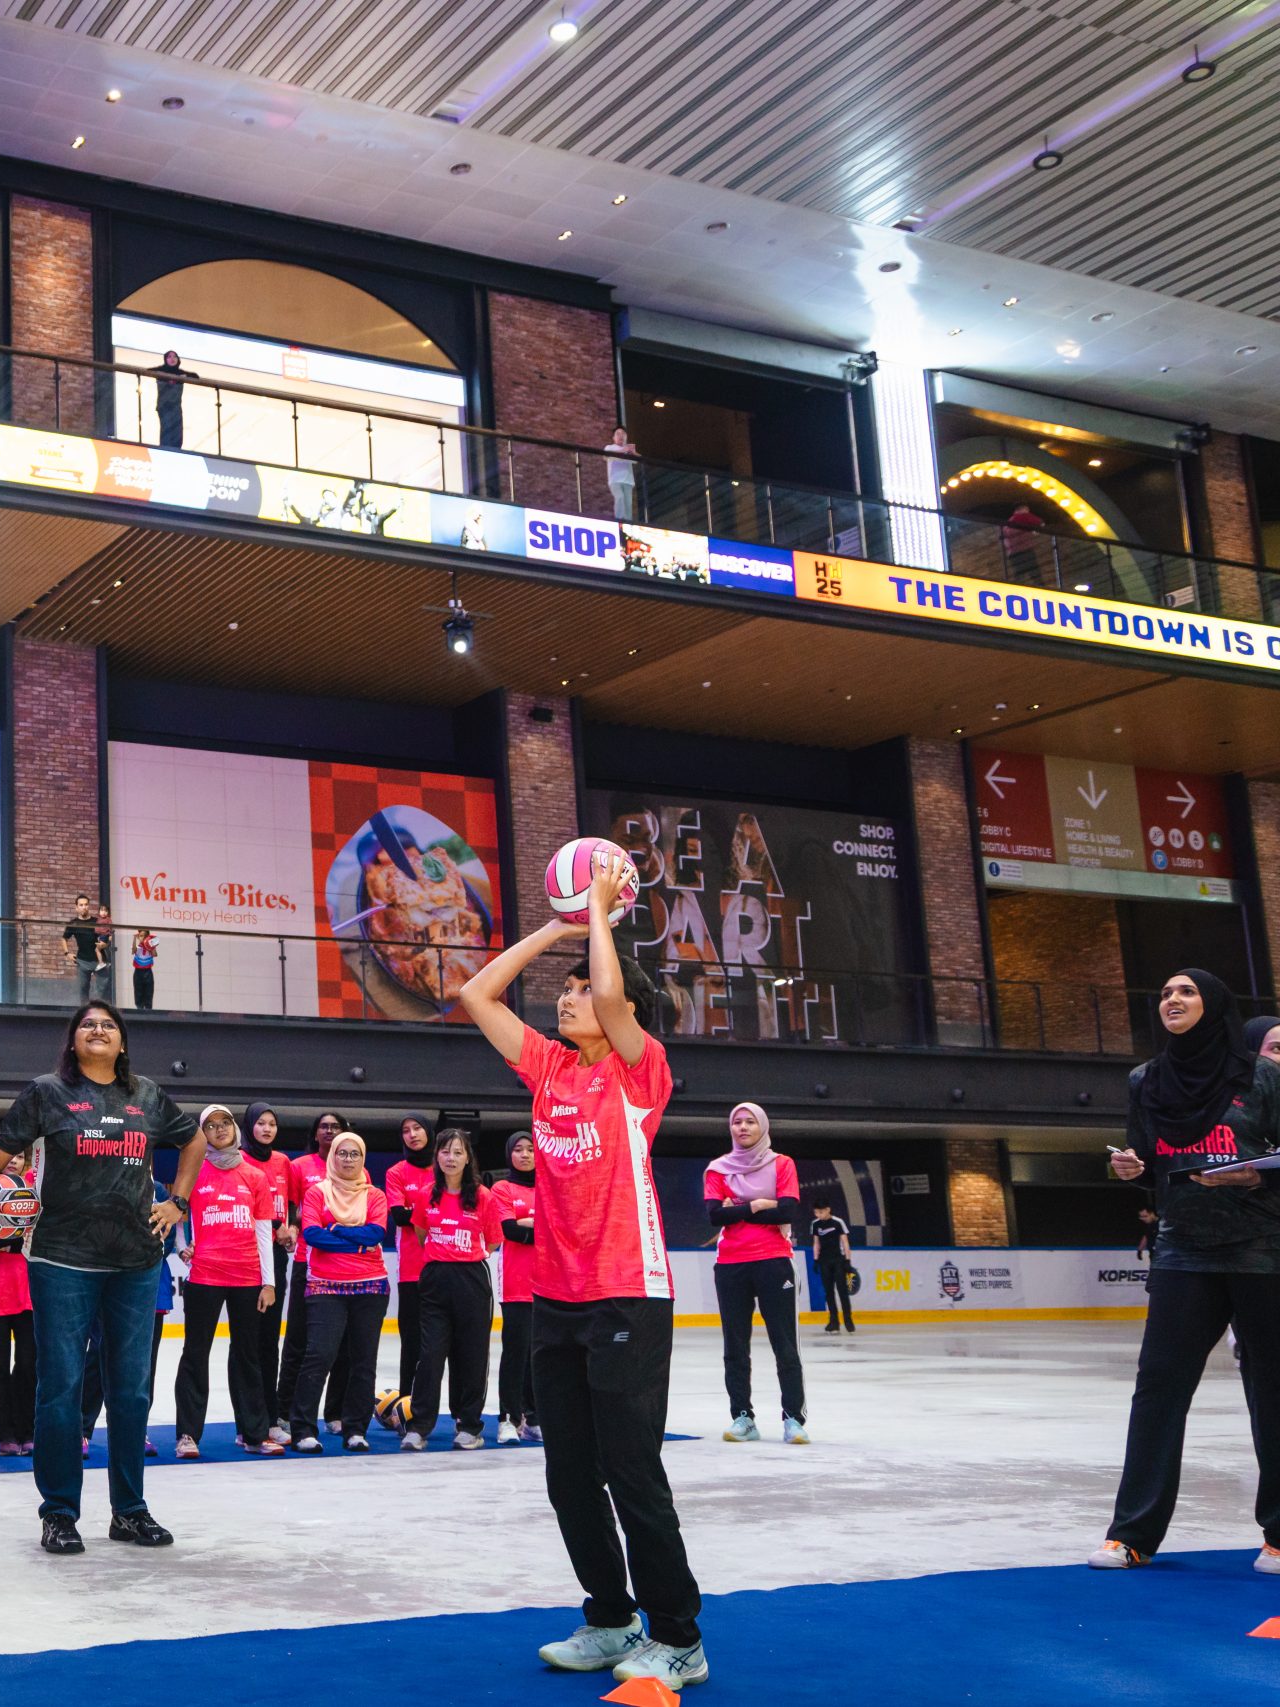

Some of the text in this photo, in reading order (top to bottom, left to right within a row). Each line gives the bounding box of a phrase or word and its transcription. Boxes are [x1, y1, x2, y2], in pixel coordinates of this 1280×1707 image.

[528, 519, 618, 559] SHOP
[709, 552, 794, 583] DISCOVER
[816, 577, 843, 597] 25
[888, 575, 967, 613] THE
[978, 589, 1211, 650] COUNTDOWN
[1223, 628, 1255, 657] IS
[859, 823, 895, 840] SHOP.
[1064, 817, 1086, 829] ZONE
[1005, 828, 1012, 838] C
[1066, 831, 1090, 843] HOME
[1097, 835, 1121, 845] LIVING
[721, 812, 785, 898] A
[832, 840, 897, 860] CONNECT.
[981, 842, 1052, 859] DIGITAL LIFESTYLE
[1068, 843, 1097, 855] HEALTH
[1105, 847, 1135, 859] BEAUTY
[856, 862, 899, 880] ENJOY.
[1171, 857, 1196, 868] LOBBY
[120, 872, 297, 914] Warm Bites,
[162, 907, 258, 925] Happy Hearts
[625, 886, 812, 980] PART
[550, 1104, 578, 1117] Mitre
[83, 1129, 106, 1139] NSL
[76, 1131, 147, 1159] EmpowerHER
[968, 1268, 1011, 1277] WHERE PASSION
[970, 1280, 987, 1290] MEETS
[988, 1280, 1013, 1289] PURPOSE
